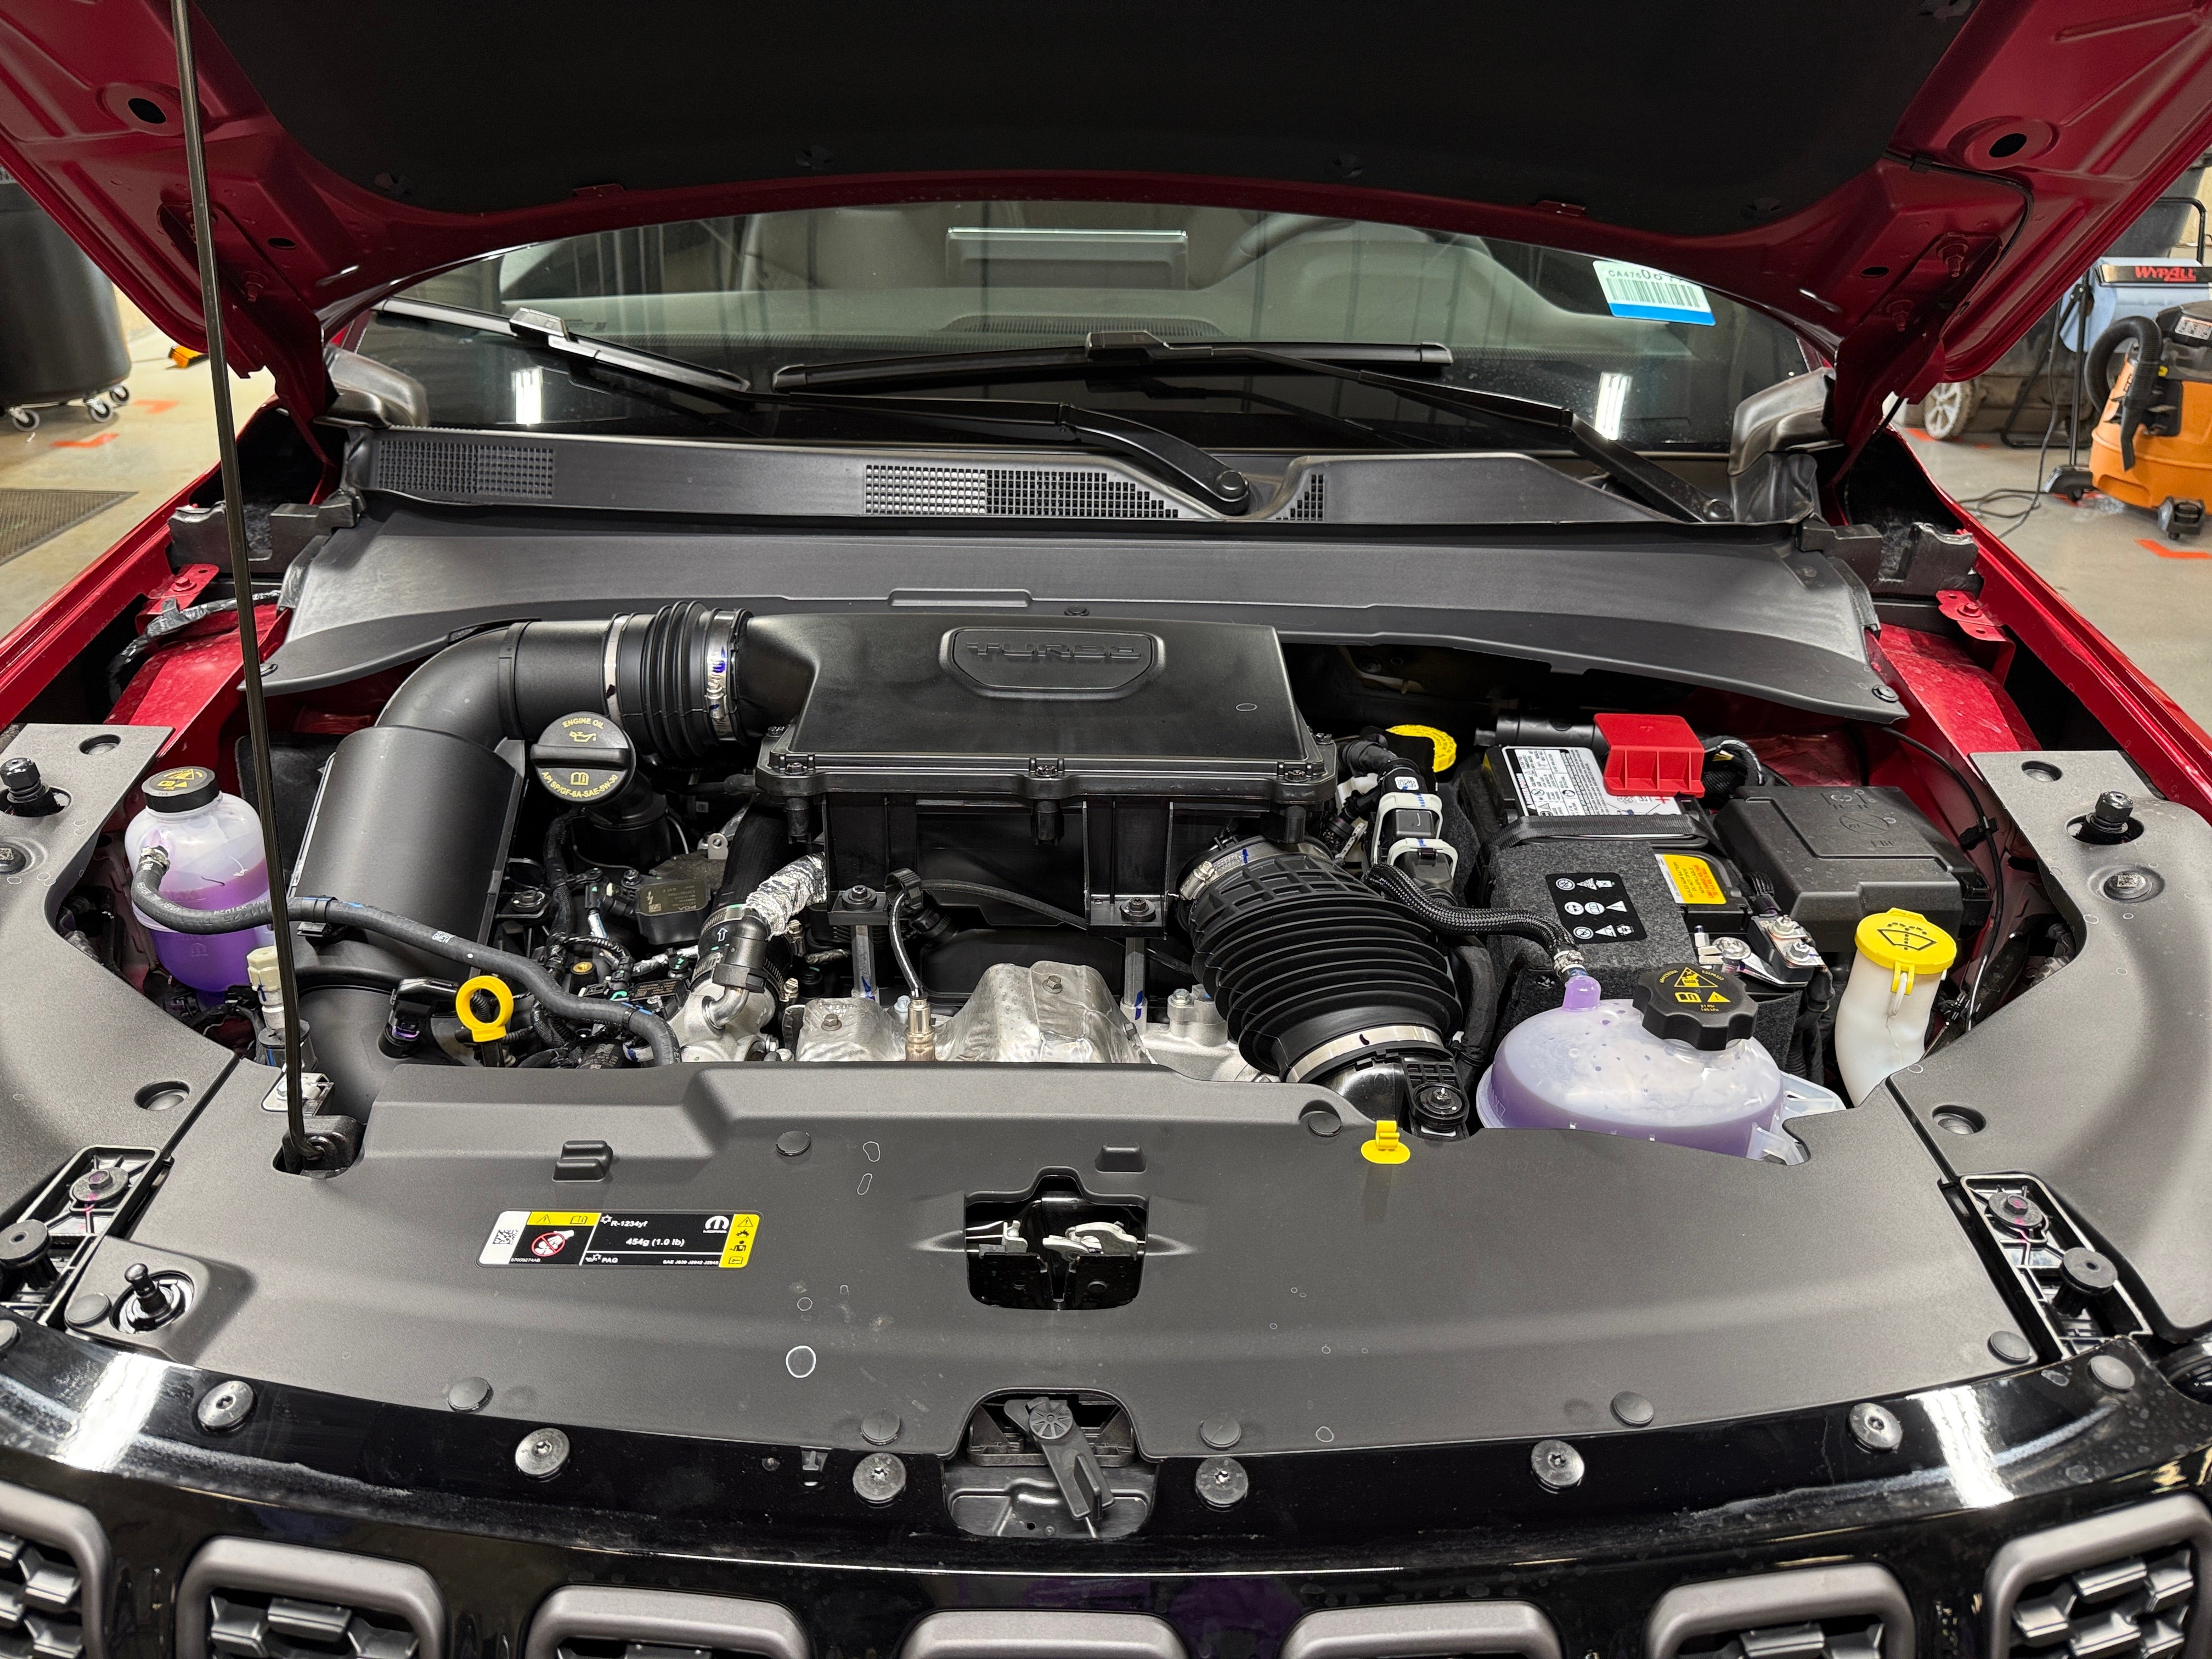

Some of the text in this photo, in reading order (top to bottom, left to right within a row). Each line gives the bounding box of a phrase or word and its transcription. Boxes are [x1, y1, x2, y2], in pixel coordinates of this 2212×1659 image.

[966, 642, 1142, 659] TURBO
[562, 718, 604, 730] ENGINE OIL
[541, 771, 553, 783] API
[1672, 862, 1683, 876] BATTERY
[213, 905, 247, 915] HEATER
[625, 1238, 685, 1247] 454g (1.0 lb)
